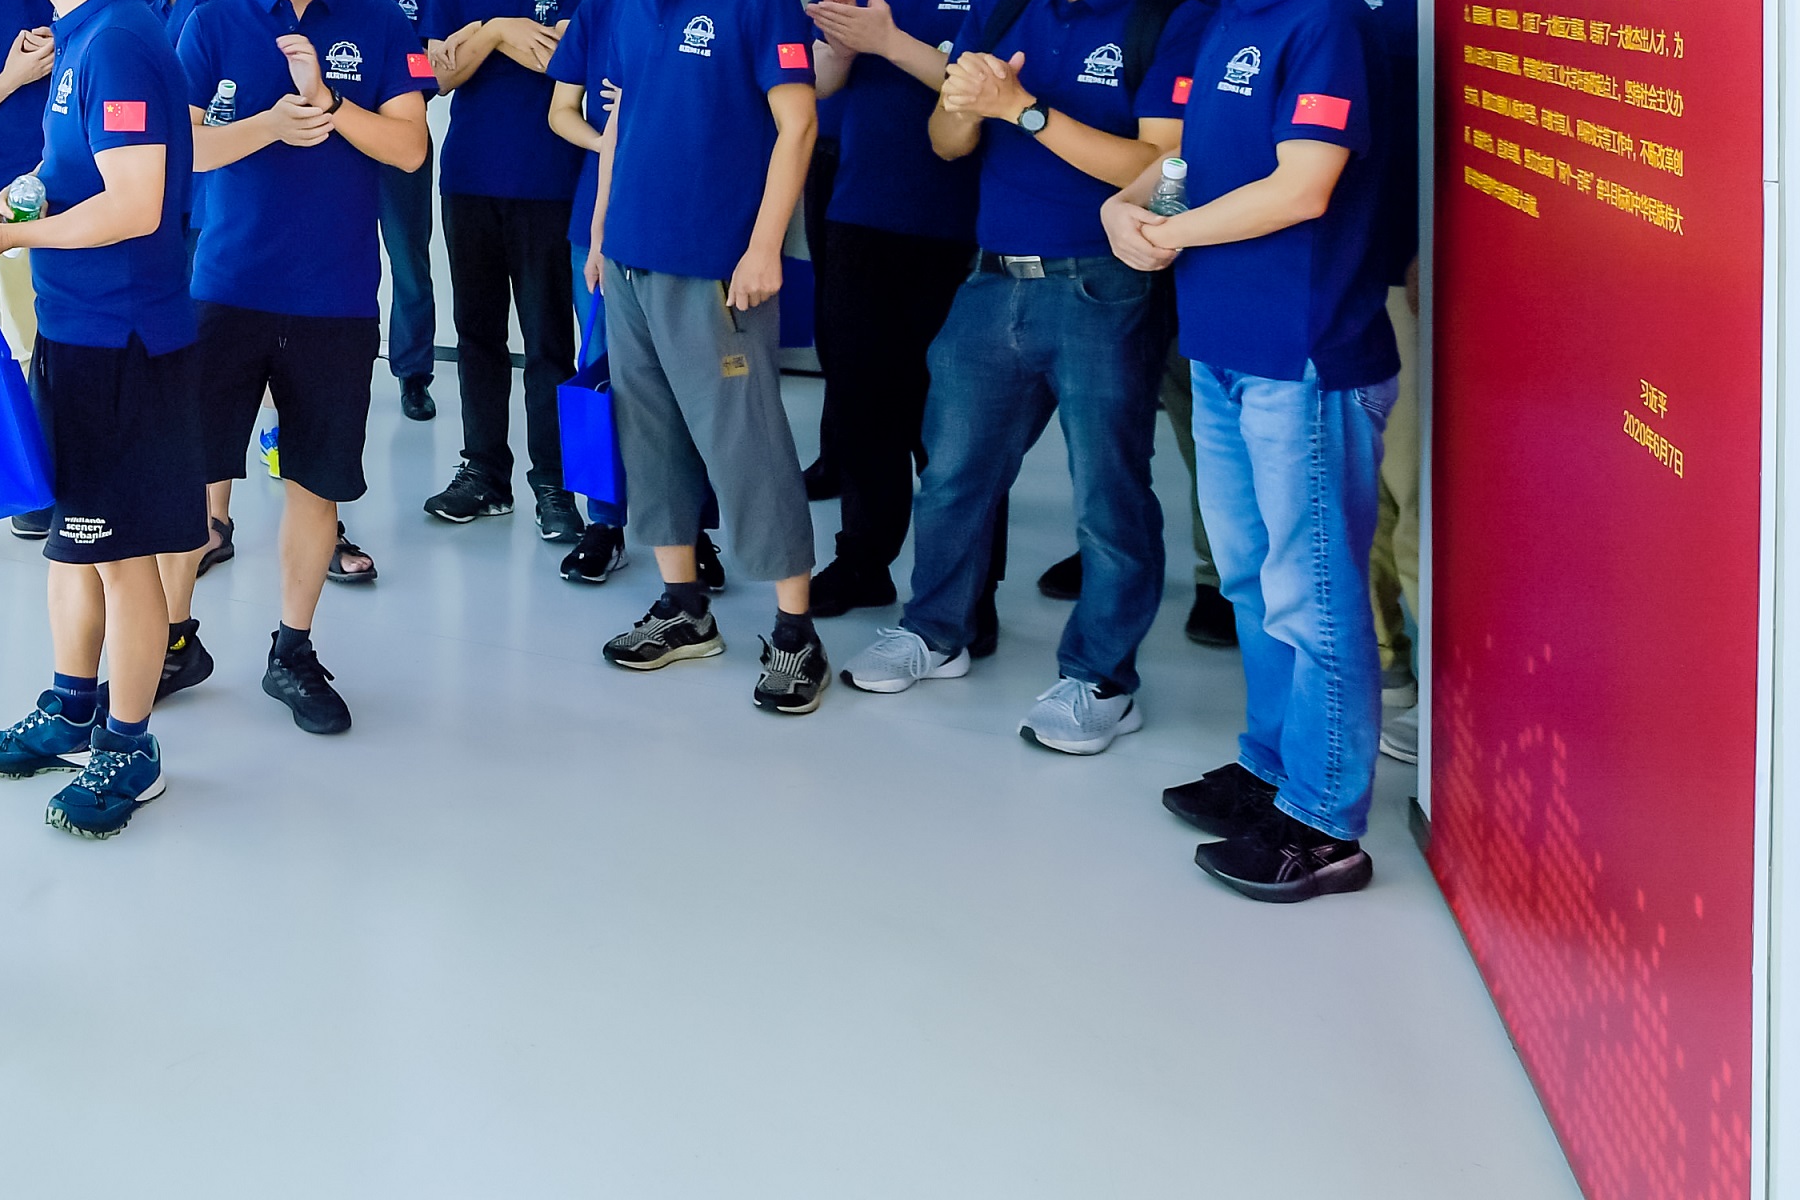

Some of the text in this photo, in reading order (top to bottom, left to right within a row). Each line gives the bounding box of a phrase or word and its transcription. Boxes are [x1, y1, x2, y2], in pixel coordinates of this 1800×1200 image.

[1640, 378, 1668, 419] 习近平
[1623, 409, 1683, 479] 2020年6月7日
